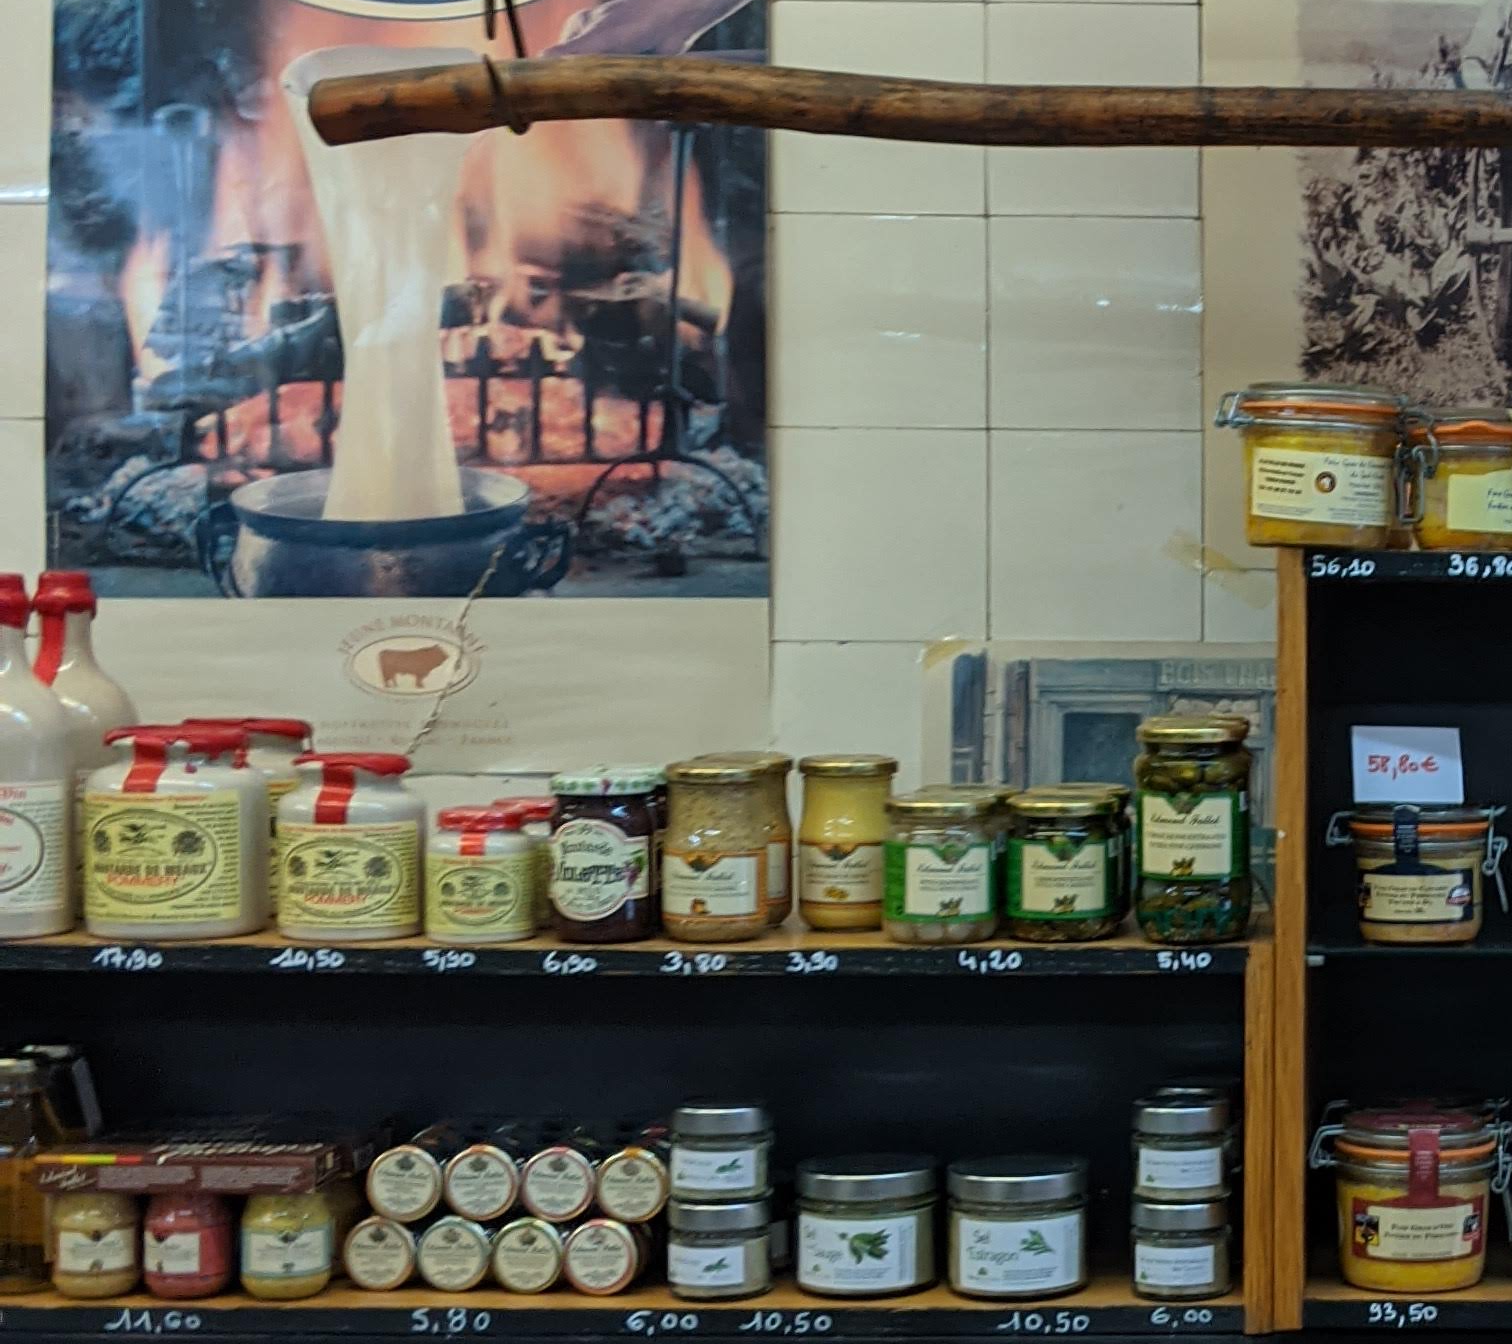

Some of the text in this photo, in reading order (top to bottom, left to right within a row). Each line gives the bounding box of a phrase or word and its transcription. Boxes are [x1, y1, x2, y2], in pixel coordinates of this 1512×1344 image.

[1310, 555, 1376, 578] 56,10
[958, 951, 1023, 973] 4,20
[1156, 951, 1213, 971] 5,40
[104, 1308, 202, 1334] 11,60
[411, 1308, 492, 1333] 5,80
[625, 1309, 700, 1335] 6,00
[738, 1311, 834, 1335] 10,50
[997, 1311, 1091, 1335] 10,50
[1150, 1307, 1214, 1327] 6,00
